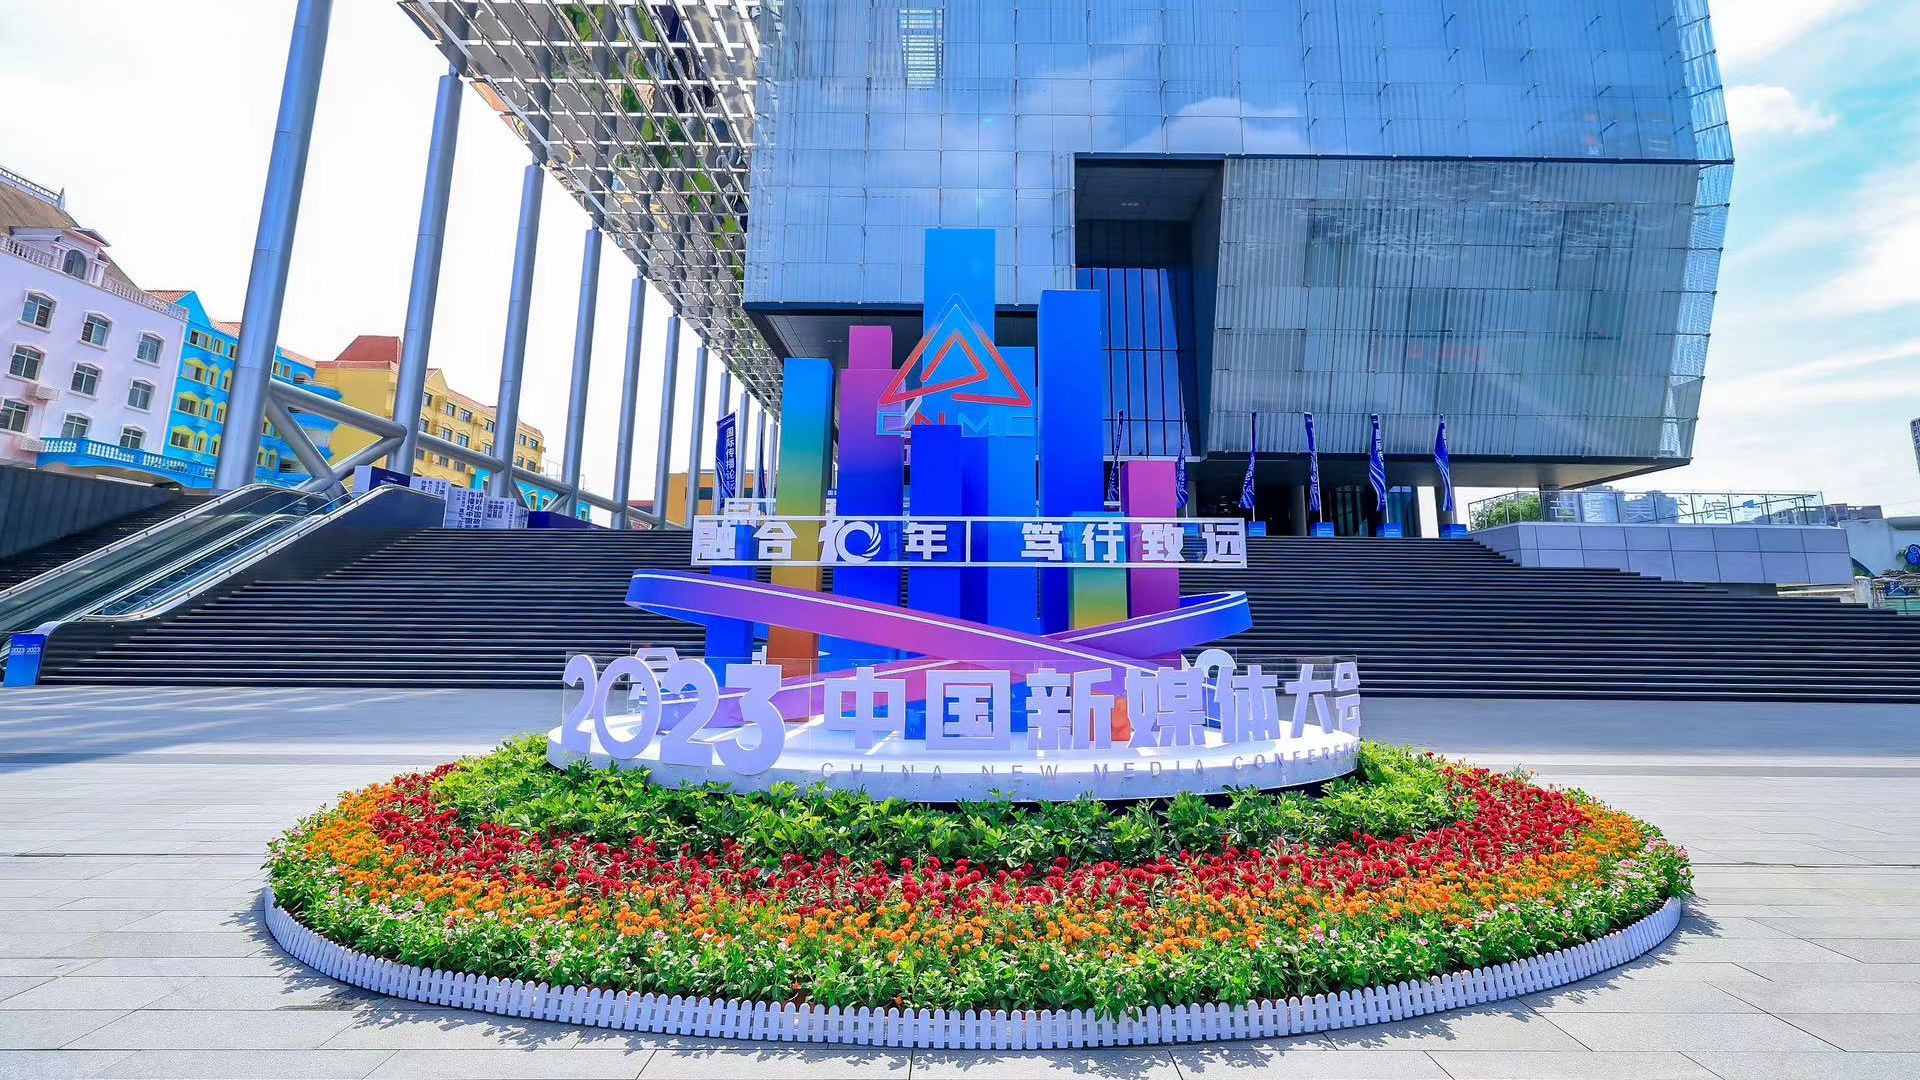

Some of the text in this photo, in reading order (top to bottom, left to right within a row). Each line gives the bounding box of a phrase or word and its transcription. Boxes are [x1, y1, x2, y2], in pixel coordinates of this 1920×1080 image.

[1021, 522, 1246, 563] 笃行致远
[562, 655, 1362, 776] 2023 中国新媒体大会
[821, 762, 944, 782] CHINA
[981, 763, 1059, 782] NEW
[1093, 759, 1205, 782] MEDIA
